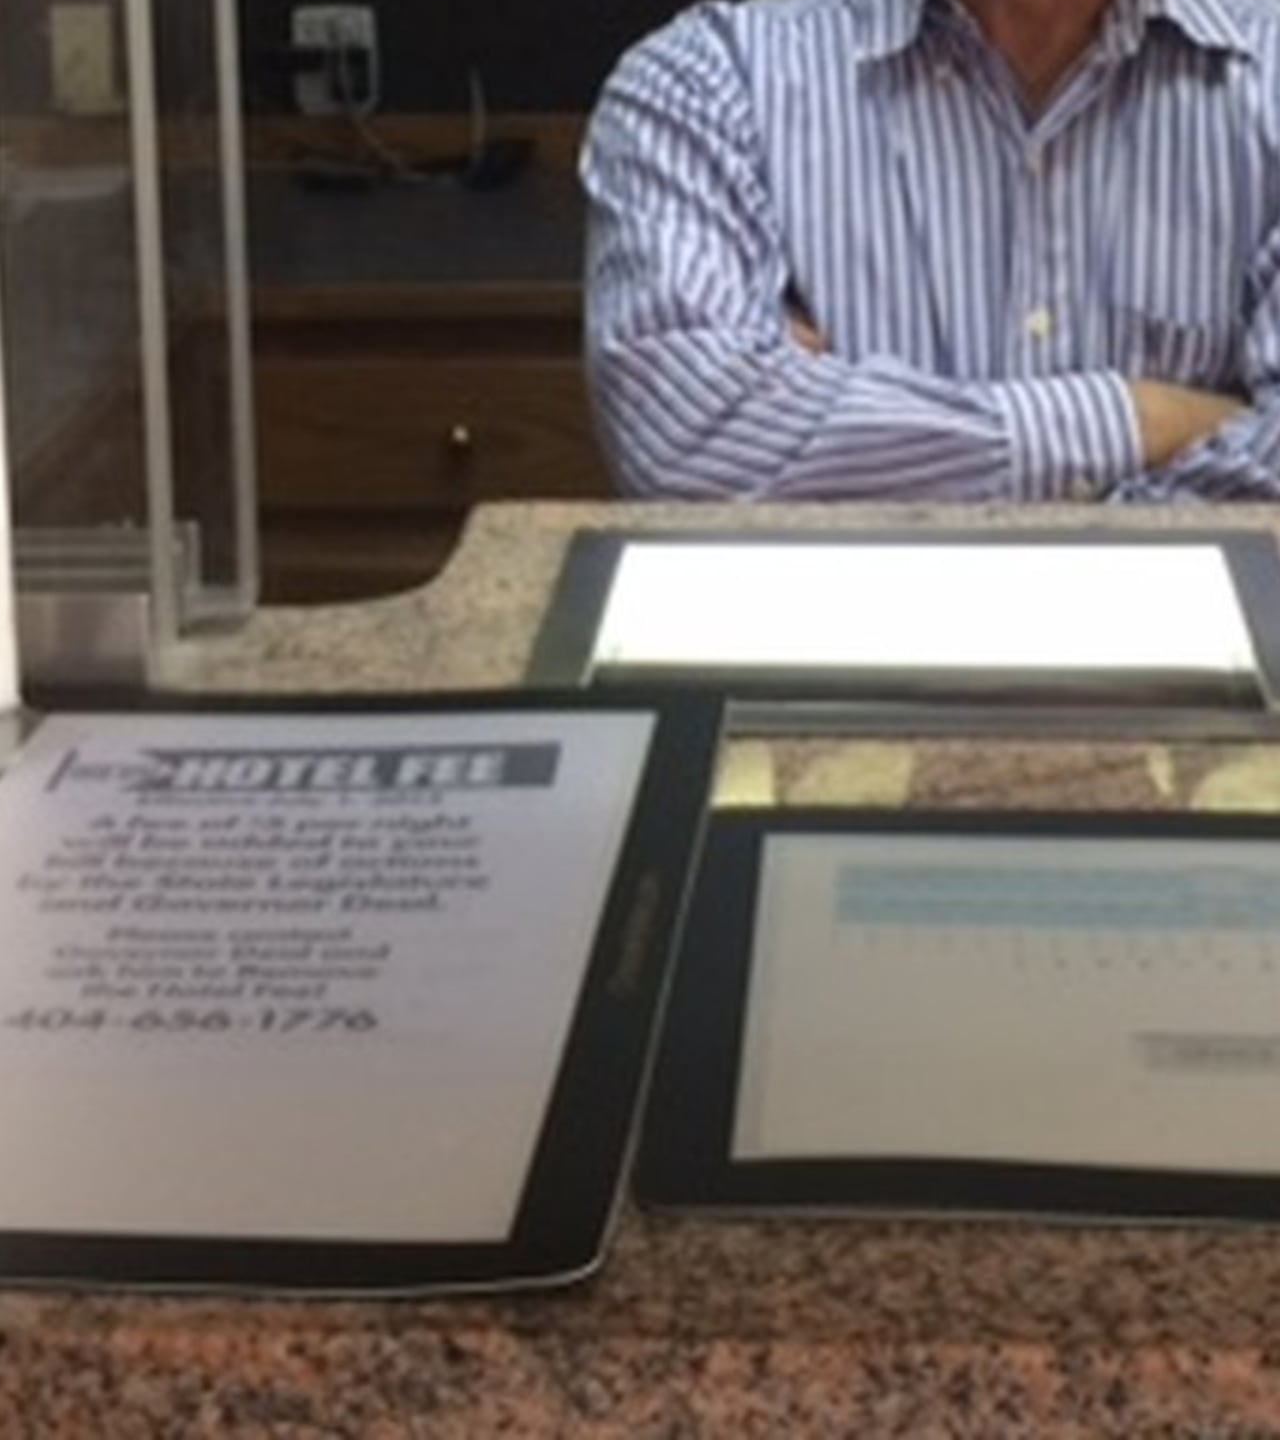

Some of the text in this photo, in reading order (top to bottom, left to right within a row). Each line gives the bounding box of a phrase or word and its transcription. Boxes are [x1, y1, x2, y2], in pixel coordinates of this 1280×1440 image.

[170, 754, 378, 788] HOTEL
[395, 751, 504, 787] FEE
[370, 812, 472, 836] night
[1, 1008, 379, 1033] 404-656-1776
